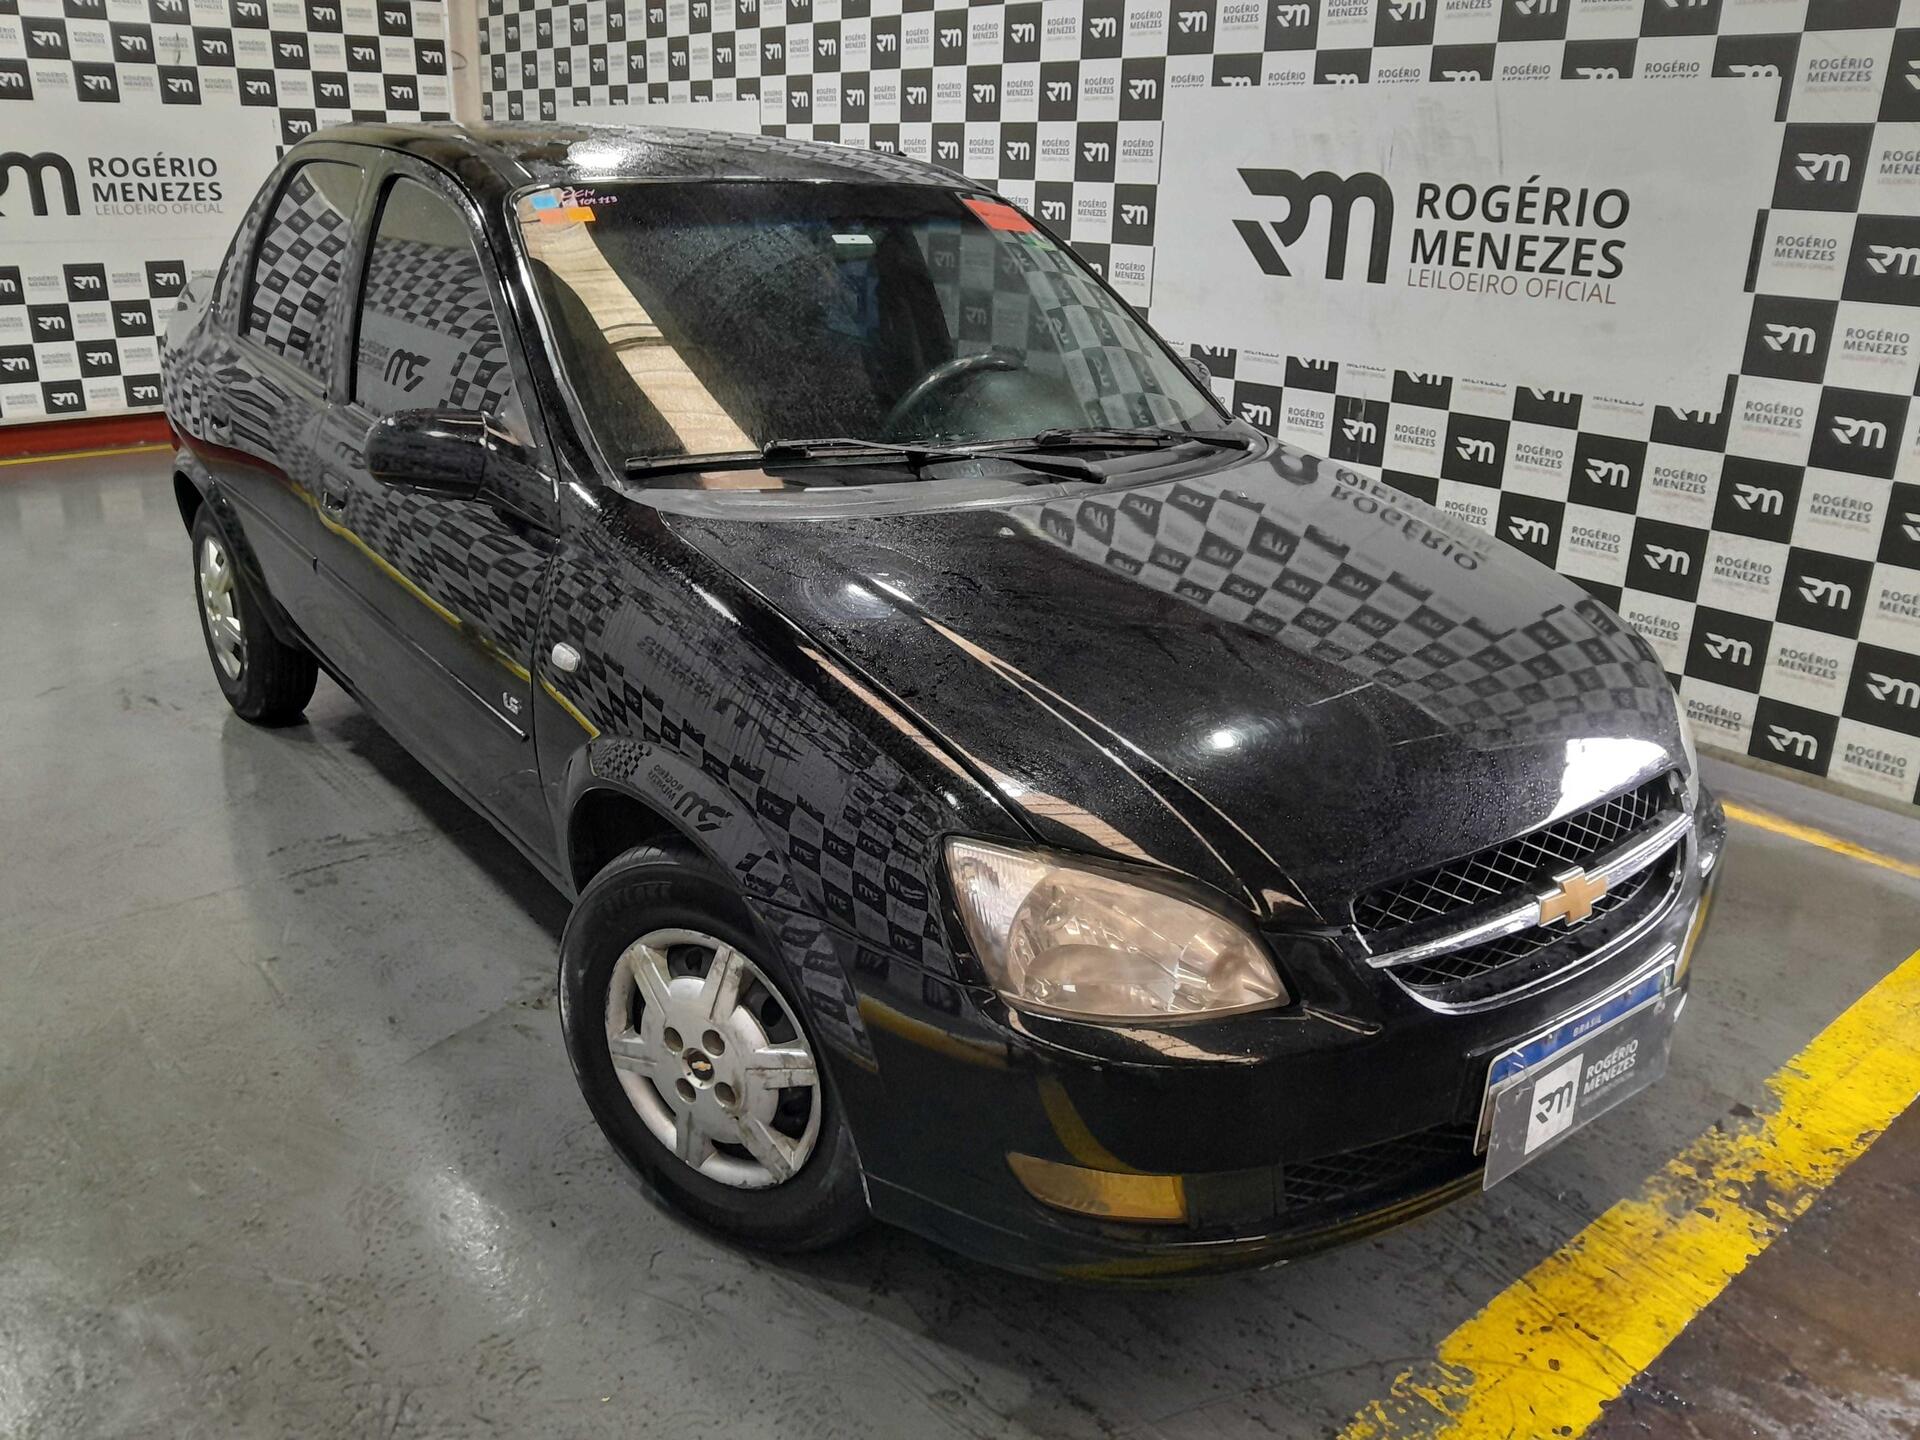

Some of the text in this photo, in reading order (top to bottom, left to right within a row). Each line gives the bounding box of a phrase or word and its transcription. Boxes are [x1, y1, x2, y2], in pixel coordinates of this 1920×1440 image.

[1130, 10, 1163, 21] ROGÉRIO
[1223, 4, 1260, 15] ROGÉRIO
[1047, 17, 1076, 27] ROGÉRIO
[1129, 20, 1163, 30] MENEZES
[1222, 13, 1260, 25] MENEZES
[1046, 26, 1077, 36] MENEZES
[1502, 63, 1552, 75] ROGÉRIO
[1644, 59, 1702, 72] ROGÉRIO
[1808, 55, 1875, 70] ROGÉRIO
[1171, 73, 1205, 83] ROGÉRIO
[1268, 69, 1307, 80] ROGÉRIO
[1378, 66, 1421, 78] ROGÉRIO
[1805, 70, 1873, 83] MENEZES
[1006, 79, 1034, 88] ROGÉRIO
[1084, 76, 1115, 86] ROGÉRIO
[1006, 88, 1034, 96] MENEZES
[1083, 85, 1115, 94] MENEZES
[1041, 137, 1070, 146] ROGÉRIO
[1122, 138, 1154, 147] ROGÉRIO
[1041, 146, 1070, 155] MENEZES
[1121, 147, 1154, 156] MENEZES
[88, 152, 218, 178] ROGÉRIO
[92, 181, 223, 203] MENEZES
[94, 202, 224, 216] LEILOEIRO OFICIAL
[1077, 198, 1107, 208] ROGÉRIO
[1416, 175, 1630, 229] ROGÉRIO
[1077, 207, 1107, 216] MENEZES
[1775, 235, 1838, 249] ROGÉRIO
[1410, 228, 1627, 279] MENEZES
[1773, 247, 1837, 262] MENEZES
[1114, 261, 1145, 271] ROGÉRIO
[1114, 269, 1145, 280] MENEZES
[1407, 268, 1617, 305] LEILOEIRO OFICIAL
[1844, 328, 1910, 344] ROGÉRIO
[1841, 339, 1908, 357] MENEZES
[1288, 406, 1325, 420] ROGÉRIO
[1744, 401, 1805, 418] ROGÉRIO
[1287, 414, 1325, 429] MENEZES
[1742, 411, 1804, 430] MENEZES
[1394, 424, 1437, 439] ROGÉRIO
[1393, 432, 1437, 448] MENEZES
[1515, 444, 1564, 460] ROGÉRIO
[1513, 453, 1563, 470] MENEZES
[1653, 467, 1709, 484] ROGÉRIO
[1651, 476, 1708, 495] MENEZES
[1810, 493, 1874, 512] ROGÉRIO
[1808, 503, 1872, 524] MENEZES
[1570, 526, 1621, 544] ROGÉRIO
[1568, 534, 1620, 554] MENEZES
[1714, 555, 1773, 575] ROGÉRIO
[1712, 564, 1771, 586] MENEZES
[1778, 647, 1839, 669] ROGÉRIO
[1775, 656, 1838, 681] MENEZES
[1687, 697, 1742, 721] ROGÉRIO
[1684, 706, 1741, 731] MENEZES
[1844, 744, 1907, 771] ROGÉRIO
[1841, 753, 1906, 782] MENEZES
[1572, 1014, 1602, 1038] BRASIL
[1586, 1038, 1639, 1078] ROGÉRIO
[1583, 1053, 1637, 1095] MENEZES
